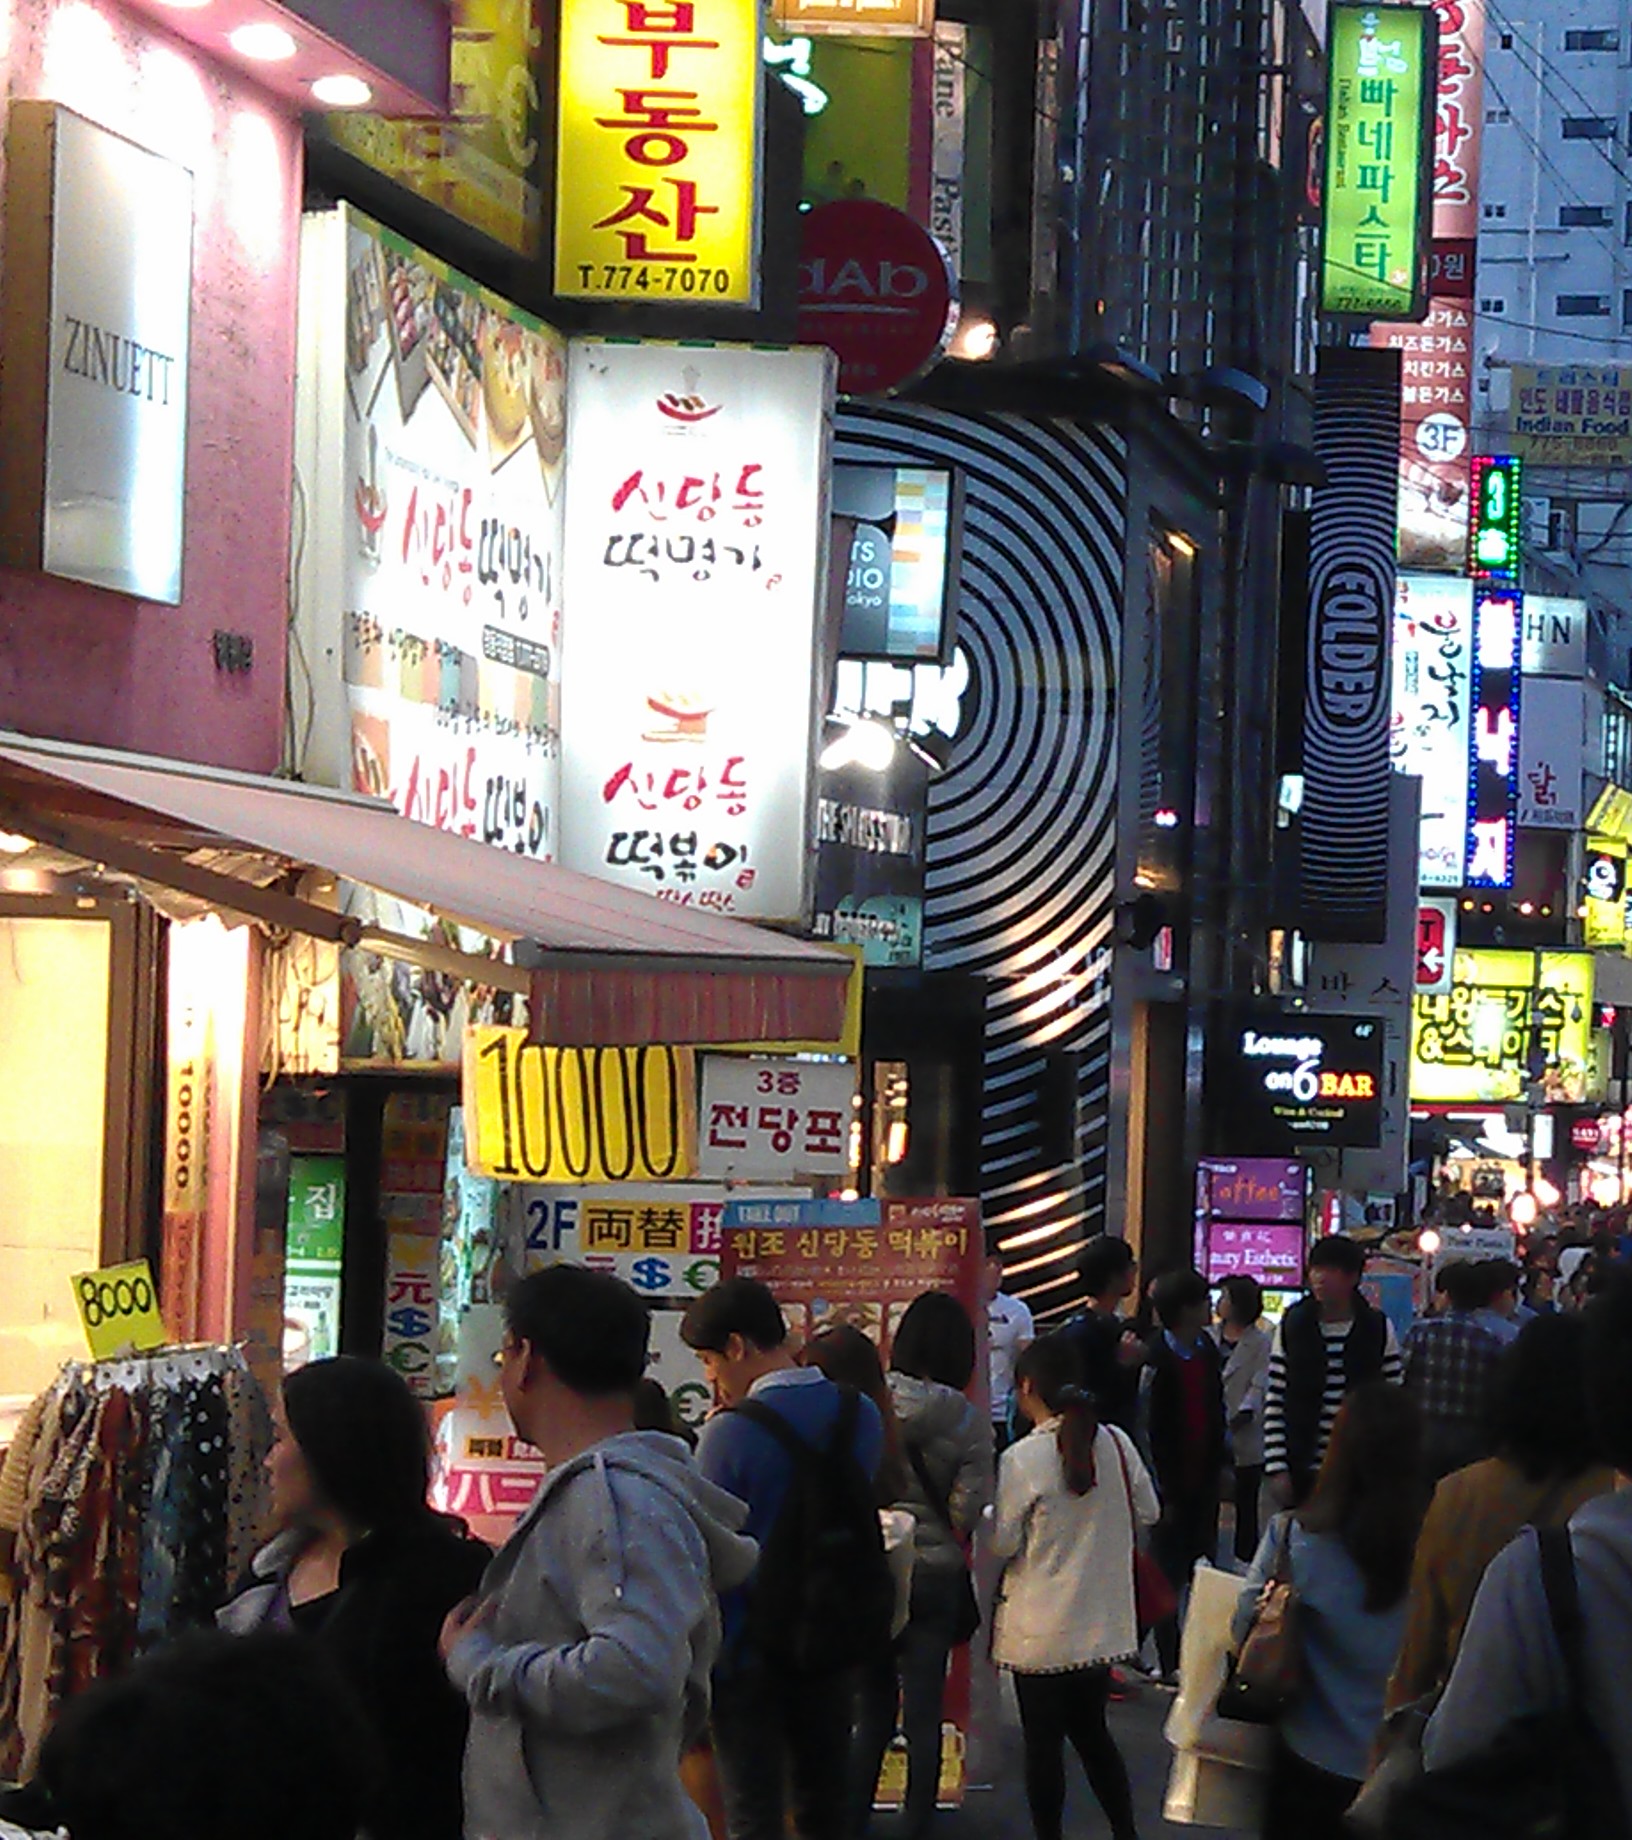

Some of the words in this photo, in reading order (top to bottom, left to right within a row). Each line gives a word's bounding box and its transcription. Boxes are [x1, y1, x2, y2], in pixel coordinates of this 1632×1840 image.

[1353, 78, 1399, 284] 빠네파스타
[577, 265, 731, 294] T.774-7070
[62, 316, 176, 406] ZINUETT
[1421, 426, 1460, 453] 3F
[1516, 415, 1575, 434] Indian
[1581, 415, 1630, 434] Food
[612, 463, 764, 528] 신당동
[1320, 570, 1380, 720] FOLDER
[603, 756, 747, 816] 신당동
[1243, 1031, 1323, 1060] Lounge
[480, 1033, 681, 1181] 10000
[1320, 1073, 1375, 1097] BAR
[709, 1103, 844, 1155] 전당포
[526, 1200, 577, 1251] 2F
[587, 1207, 685, 1249] 両替
[731, 1229, 786, 1261] 원조
[796, 1228, 880, 1262] 신당동
[888, 1228, 968, 1262] 떡볶이
[80, 1275, 152, 1329] 8000
